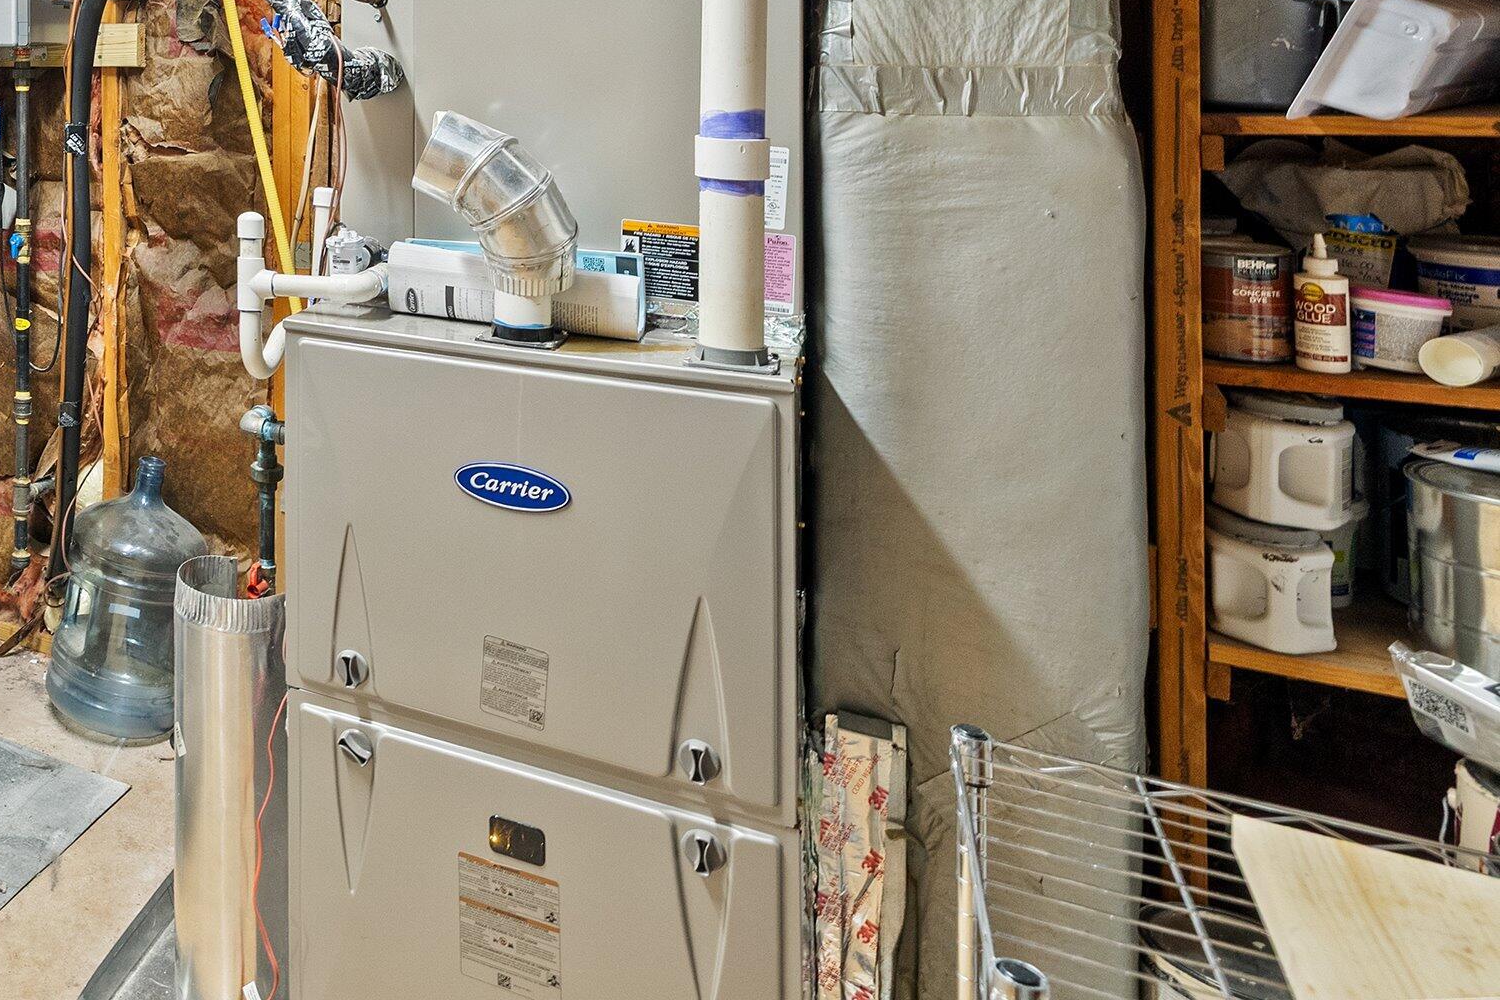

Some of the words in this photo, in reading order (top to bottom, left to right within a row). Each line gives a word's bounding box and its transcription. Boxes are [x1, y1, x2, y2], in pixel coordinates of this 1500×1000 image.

[1237, 259, 1267, 270] BEHR
[1232, 288, 1281, 298] CONCRETE
[1295, 301, 1336, 314] WOOD
[1297, 310, 1331, 324] GLUE
[469, 472, 554, 501] Carrier
[823, 752, 837, 777] 3M
[868, 785, 889, 811] 3M
[861, 850, 884, 876] 3M
[857, 919, 880, 945] 3M
